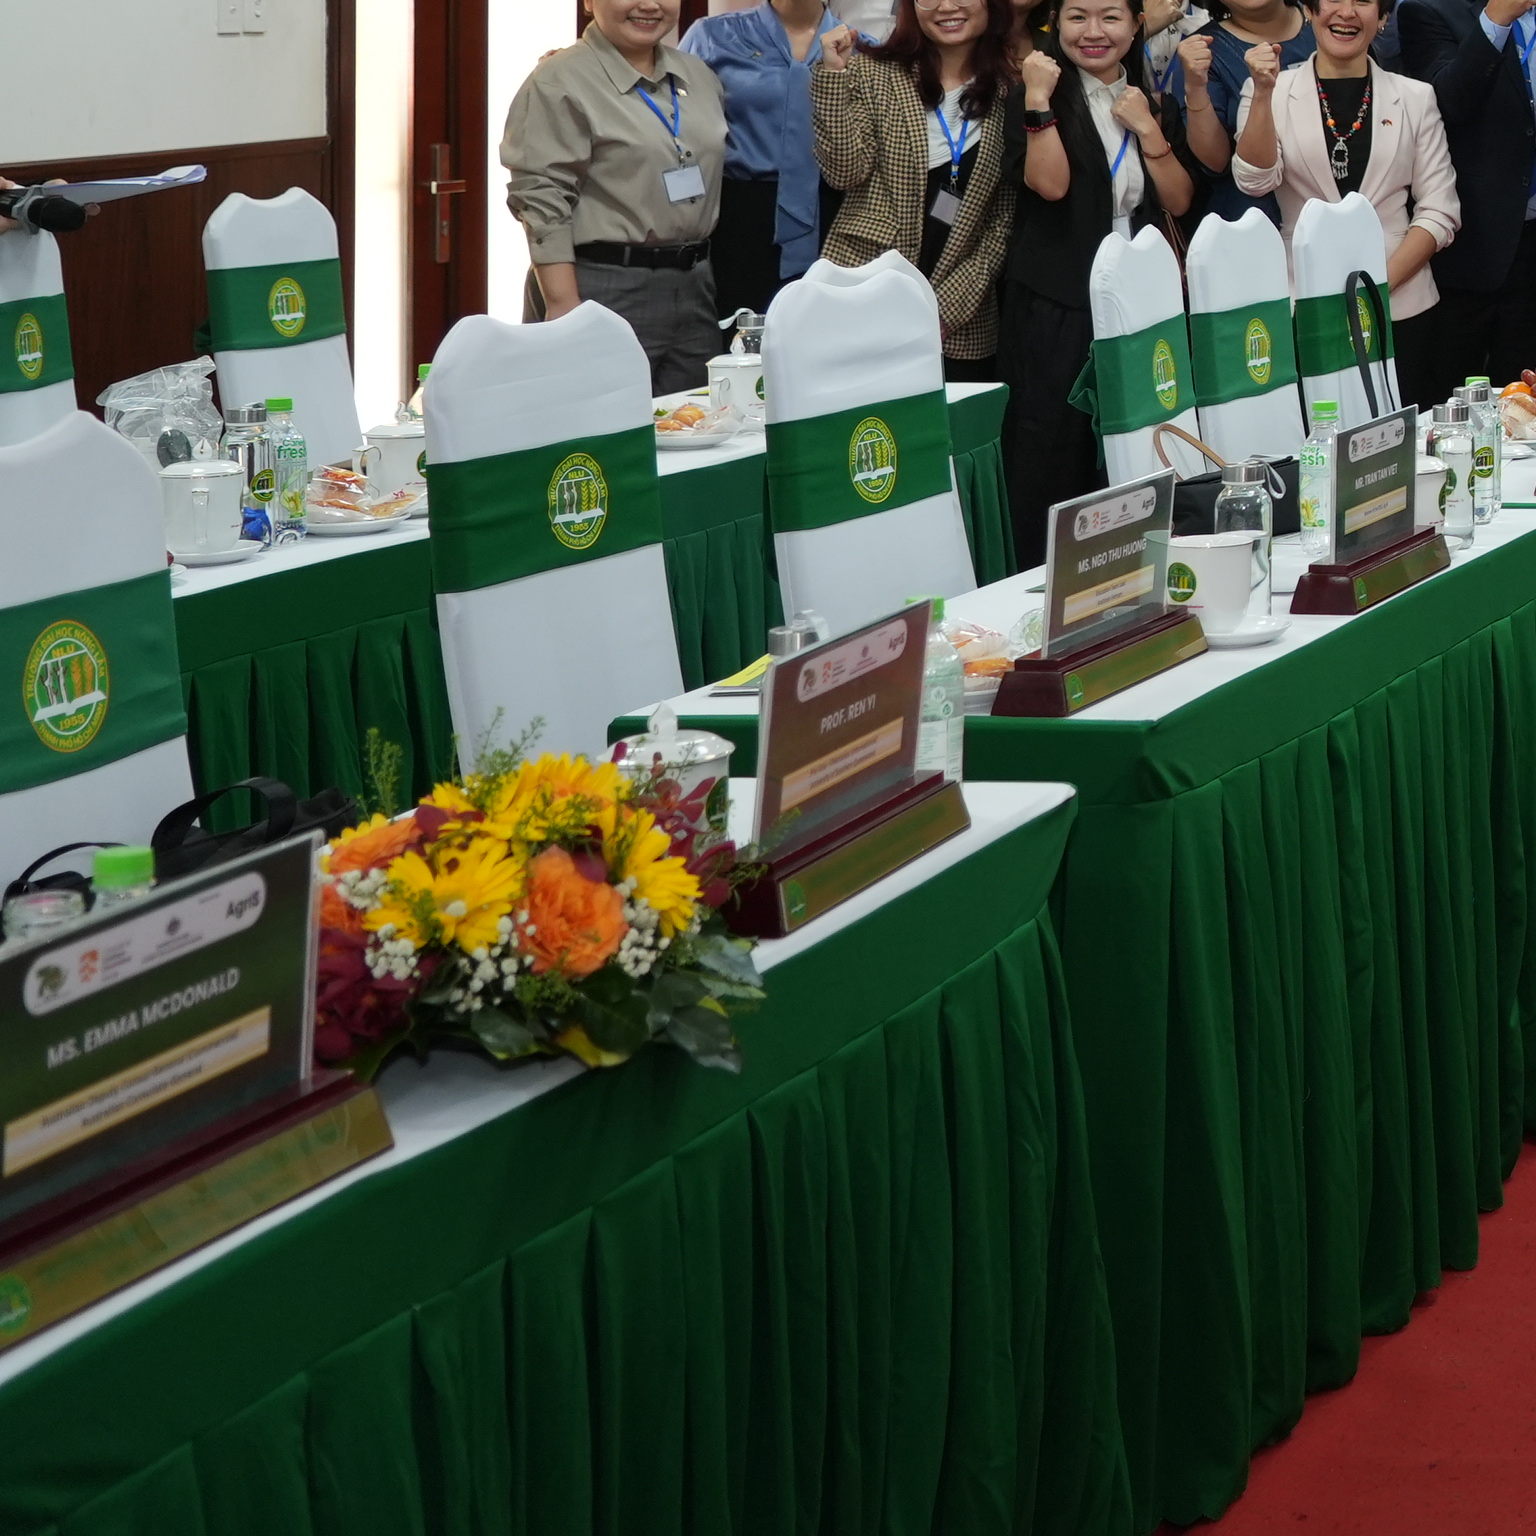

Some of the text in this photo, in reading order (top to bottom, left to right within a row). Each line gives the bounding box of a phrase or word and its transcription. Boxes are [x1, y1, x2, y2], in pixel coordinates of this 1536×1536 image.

[47, 967, 240, 1069] MS. EMMA MCDONALD
